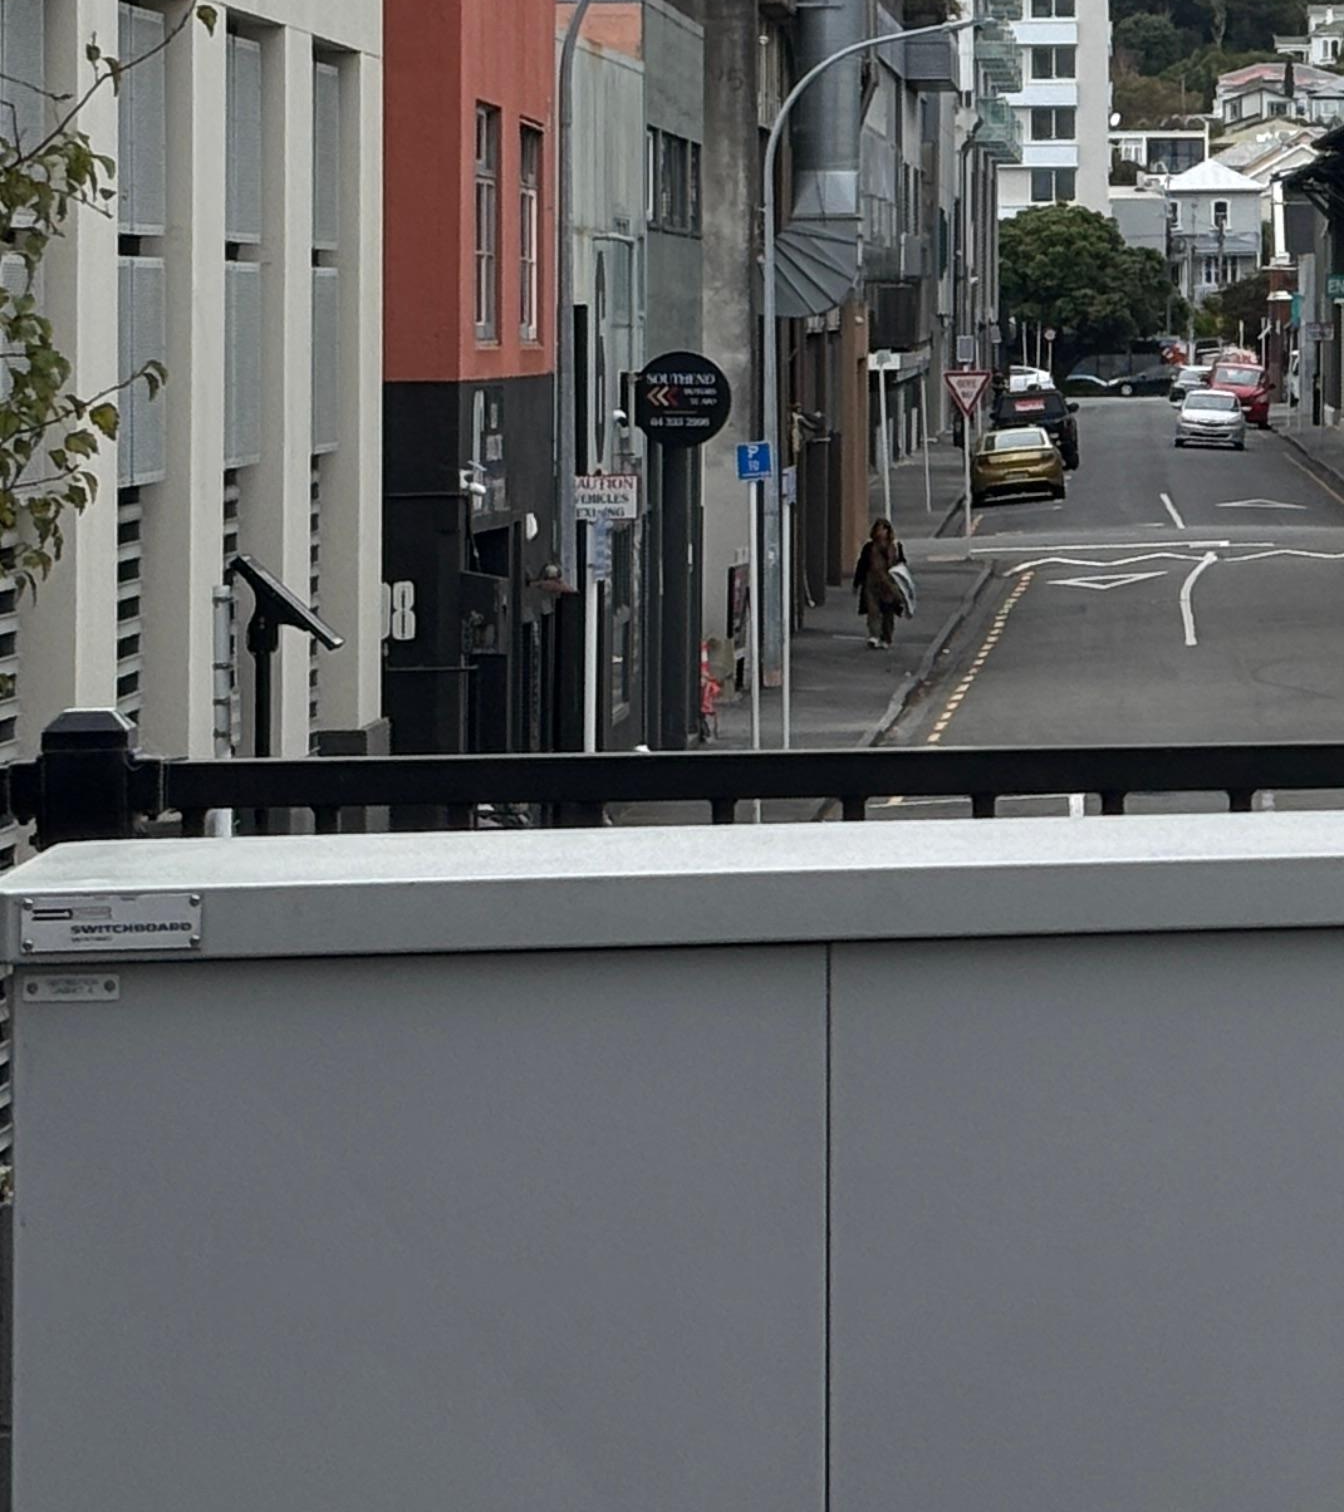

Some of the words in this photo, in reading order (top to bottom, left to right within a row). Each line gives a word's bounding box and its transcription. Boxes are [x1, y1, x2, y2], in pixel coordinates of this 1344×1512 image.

[646, 374, 716, 385] SOUTHEND
[747, 445, 760, 459] P
[576, 476, 634, 489] AUTION
[70, 922, 192, 934] SWITCHBOARD
